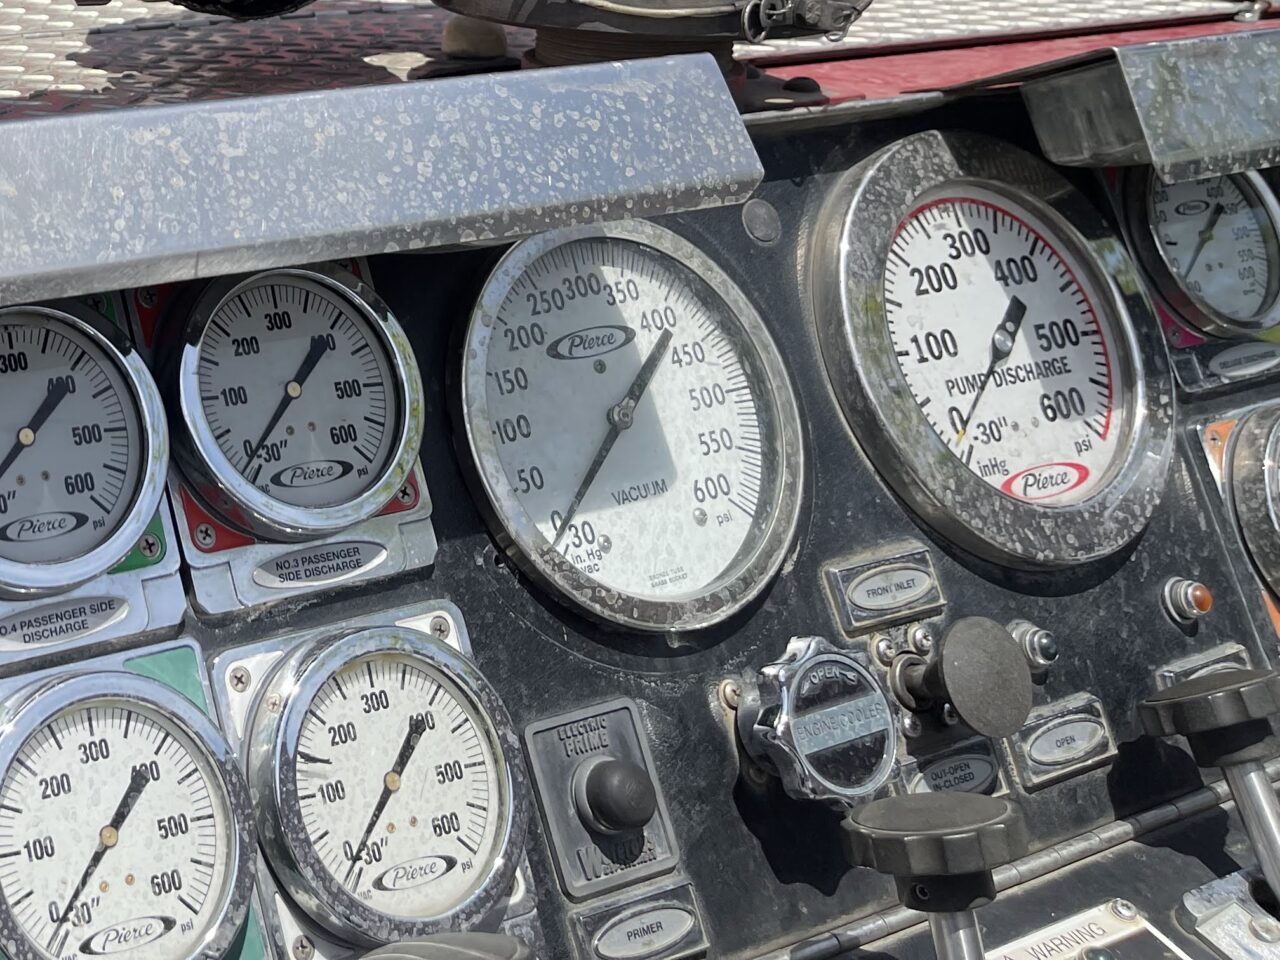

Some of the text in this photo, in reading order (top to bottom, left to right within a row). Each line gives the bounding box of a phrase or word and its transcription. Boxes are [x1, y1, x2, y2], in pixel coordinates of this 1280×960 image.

[943, 228, 990, 260] 300
[910, 263, 958, 296] 200
[995, 255, 1038, 287] 400
[562, 273, 601, 301] 300
[603, 279, 639, 306] 350
[527, 288, 565, 316] 250
[264, 311, 292, 331] 300
[640, 306, 676, 333] 400
[232, 336, 260, 356] 200
[504, 322, 544, 352] 200
[568, 332, 616, 356] Pierce
[911, 329, 958, 363] 100
[1034, 318, 1079, 352] 500
[671, 341, 705, 368] 450
[494, 367, 528, 396] 150
[945, 356, 1072, 397] PUMP DISCHARGE
[221, 386, 247, 407] 100
[334, 379, 362, 400] 500
[689, 382, 725, 411] 500
[1040, 387, 1085, 422] 600
[496, 414, 531, 445] 100
[948, 406, 966, 435] 0
[72, 423, 102, 446] 500
[330, 423, 357, 445] 600
[698, 428, 733, 455] 550
[1074, 434, 1093, 456] psi
[243, 439, 253, 458] 0
[290, 465, 334, 484] Pierce
[357, 465, 369, 478] psi
[518, 465, 544, 494] 50
[977, 457, 1010, 478] inHg
[64, 472, 95, 495] 600
[611, 478, 669, 506] VACUUM
[693, 473, 731, 503] 600
[1022, 471, 1070, 496] Pierce
[17, 516, 67, 538] Pierce
[92, 516, 106, 531] psi
[550, 510, 564, 533] 0
[716, 509, 733, 527] psi
[569, 521, 596, 548] 30
[275, 547, 361, 571] NO.3 PASSENGER
[587, 548, 603, 563] Hg
[278, 558, 363, 583] SIDE DISCHARGE
[866, 578, 916, 599] FRONT INLET
[19, 607, 87, 632] PASSENGER
[90, 600, 116, 614] SIDE
[23, 620, 89, 644] DISCHARGE
[809, 665, 840, 685] OPEN
[360, 690, 389, 714] 300
[557, 717, 607, 741] ELECTRIC
[797, 702, 884, 741] ENGINE COOLER
[328, 722, 357, 747] 200
[563, 732, 608, 758] PRIME
[1055, 735, 1076, 748] OPEN
[78, 738, 110, 765] 300
[435, 760, 463, 785] 500
[930, 763, 971, 781] OUT-OPEN
[932, 772, 975, 791] IN-CLOSED
[39, 773, 72, 800] 200
[318, 780, 346, 804] 100
[156, 812, 189, 840] 500
[431, 812, 460, 837] 600
[23, 835, 56, 862] 100
[343, 840, 353, 862] 0
[392, 861, 437, 888] Pierce
[461, 858, 473, 873] psi
[150, 869, 182, 896] 600
[48, 901, 59, 923] 0
[102, 923, 153, 951] Pierce
[180, 918, 194, 935] psi
[626, 921, 664, 942] PRIMER
[1025, 922, 1107, 960] WARNING
